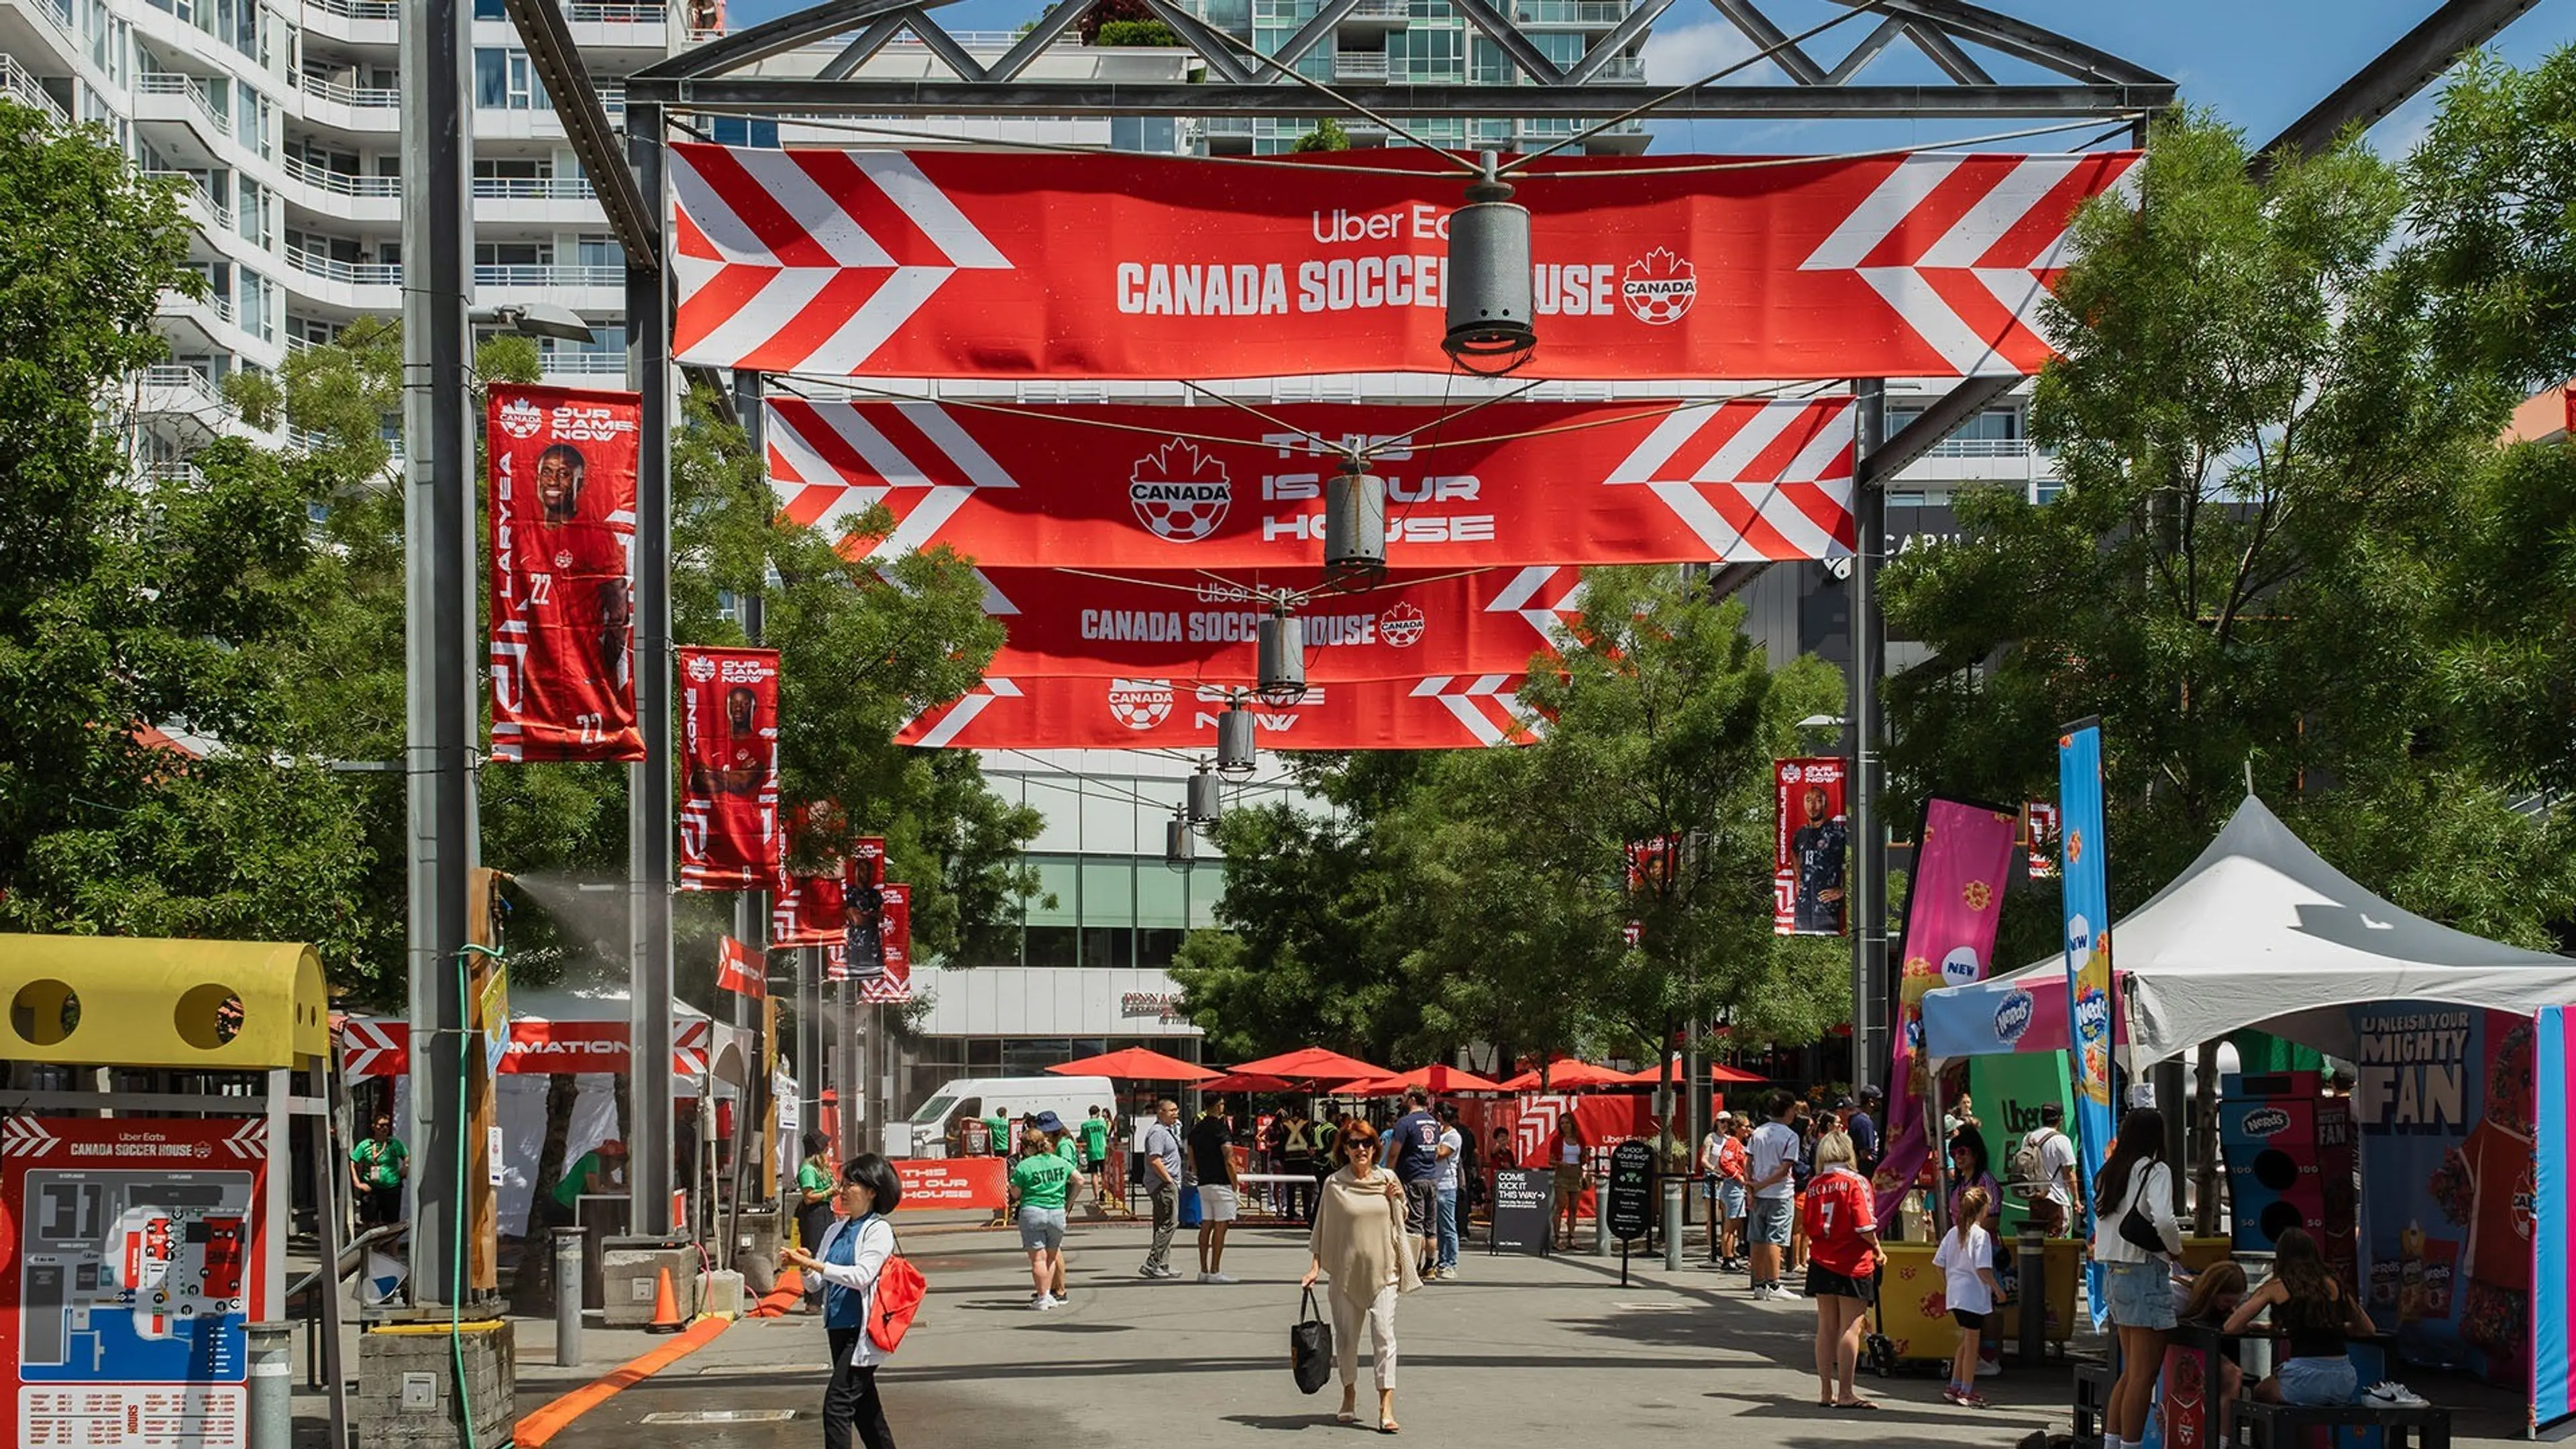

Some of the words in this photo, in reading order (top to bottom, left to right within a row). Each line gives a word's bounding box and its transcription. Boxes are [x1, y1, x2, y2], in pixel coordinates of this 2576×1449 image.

[1313, 209, 1403, 243] Uber
[1117, 262, 1289, 316] CANADA
[1623, 281, 1696, 295] CANADA
[500, 413, 543, 423] CANADA
[551, 406, 612, 419] OUR
[551, 418, 633, 432] GAME
[551, 429, 617, 441] NOW
[1130, 483, 1229, 502] CANADA
[1263, 474, 1320, 500] IS
[1384, 475, 1481, 502] UR
[498, 451, 513, 598] LARYEA
[529, 573, 552, 605] 22
[1196, 583, 1248, 603] Uber
[1081, 609, 1183, 643] CANADA
[1188, 611, 1275, 643] SOCC
[1381, 621, 1424, 631] CANADA
[721, 660, 760, 669] OUR
[721, 675, 763, 684] NOW
[1108, 691, 1174, 703] CANADA
[576, 712, 607, 745] 22
[1195, 712, 1299, 731] NW
[1947, 961, 1976, 977] NEW
[2428, 1011, 2469, 1030] YOUR
[2359, 1029, 2468, 1063] MIGHTY
[2359, 1063, 2463, 1124] FAN
[70, 1142, 113, 1156] CANADA
[115, 1143, 157, 1157] SOCCER
[158, 1144, 193, 1157] HOUSE
[1622, 1146, 1644, 1154] SHOOT
[902, 1168, 947, 1177] THIS
[1032, 1167, 1065, 1185] STAFF
[1498, 1172, 1525, 1181] COME
[924, 1179, 968, 1187] OUR
[1498, 1190, 1517, 1199] THIS
[1518, 1191, 1538, 1199] WAY
[1821, 1201, 1835, 1240] 7
